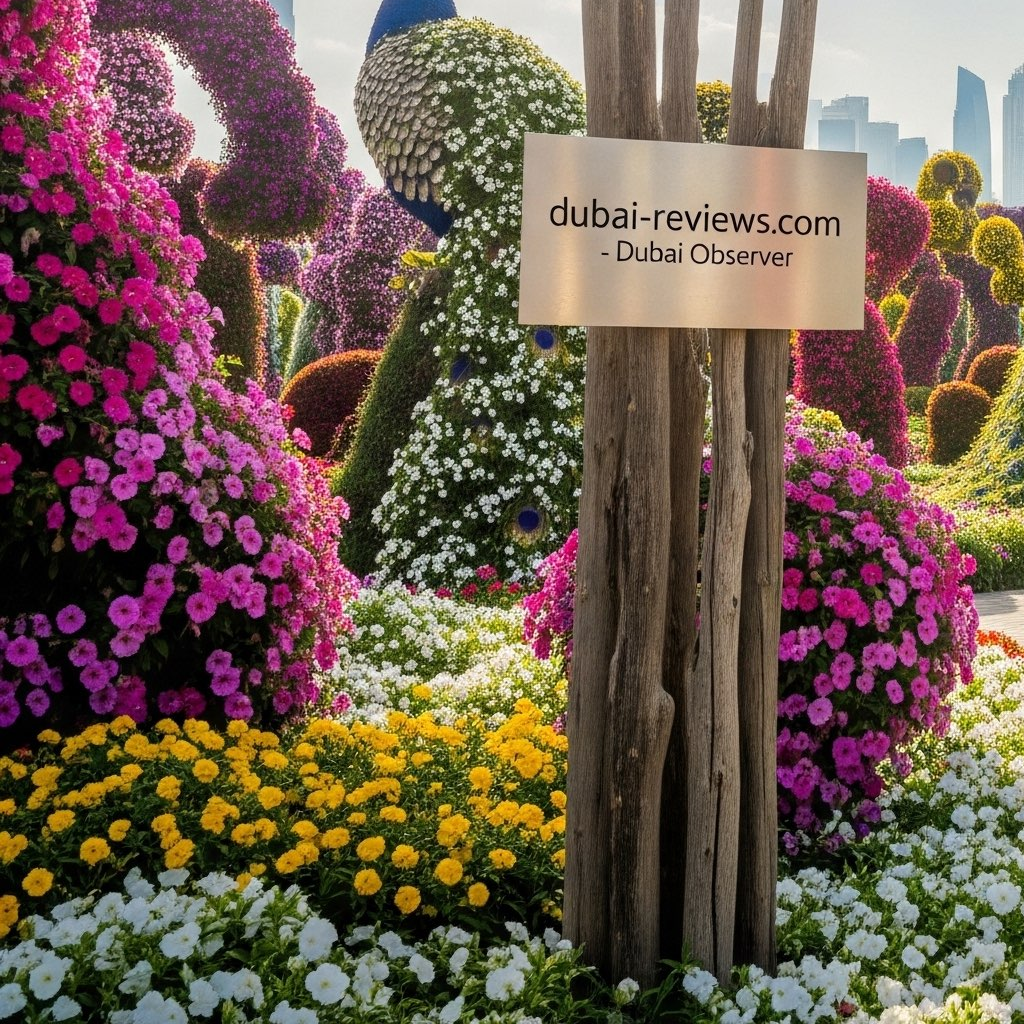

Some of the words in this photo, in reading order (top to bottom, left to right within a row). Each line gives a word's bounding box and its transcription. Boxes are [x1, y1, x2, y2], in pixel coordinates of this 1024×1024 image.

[549, 196, 840, 237] dubai-reviews.com
[616, 240, 683, 264] Dubai
[690, 243, 794, 267] Observer
